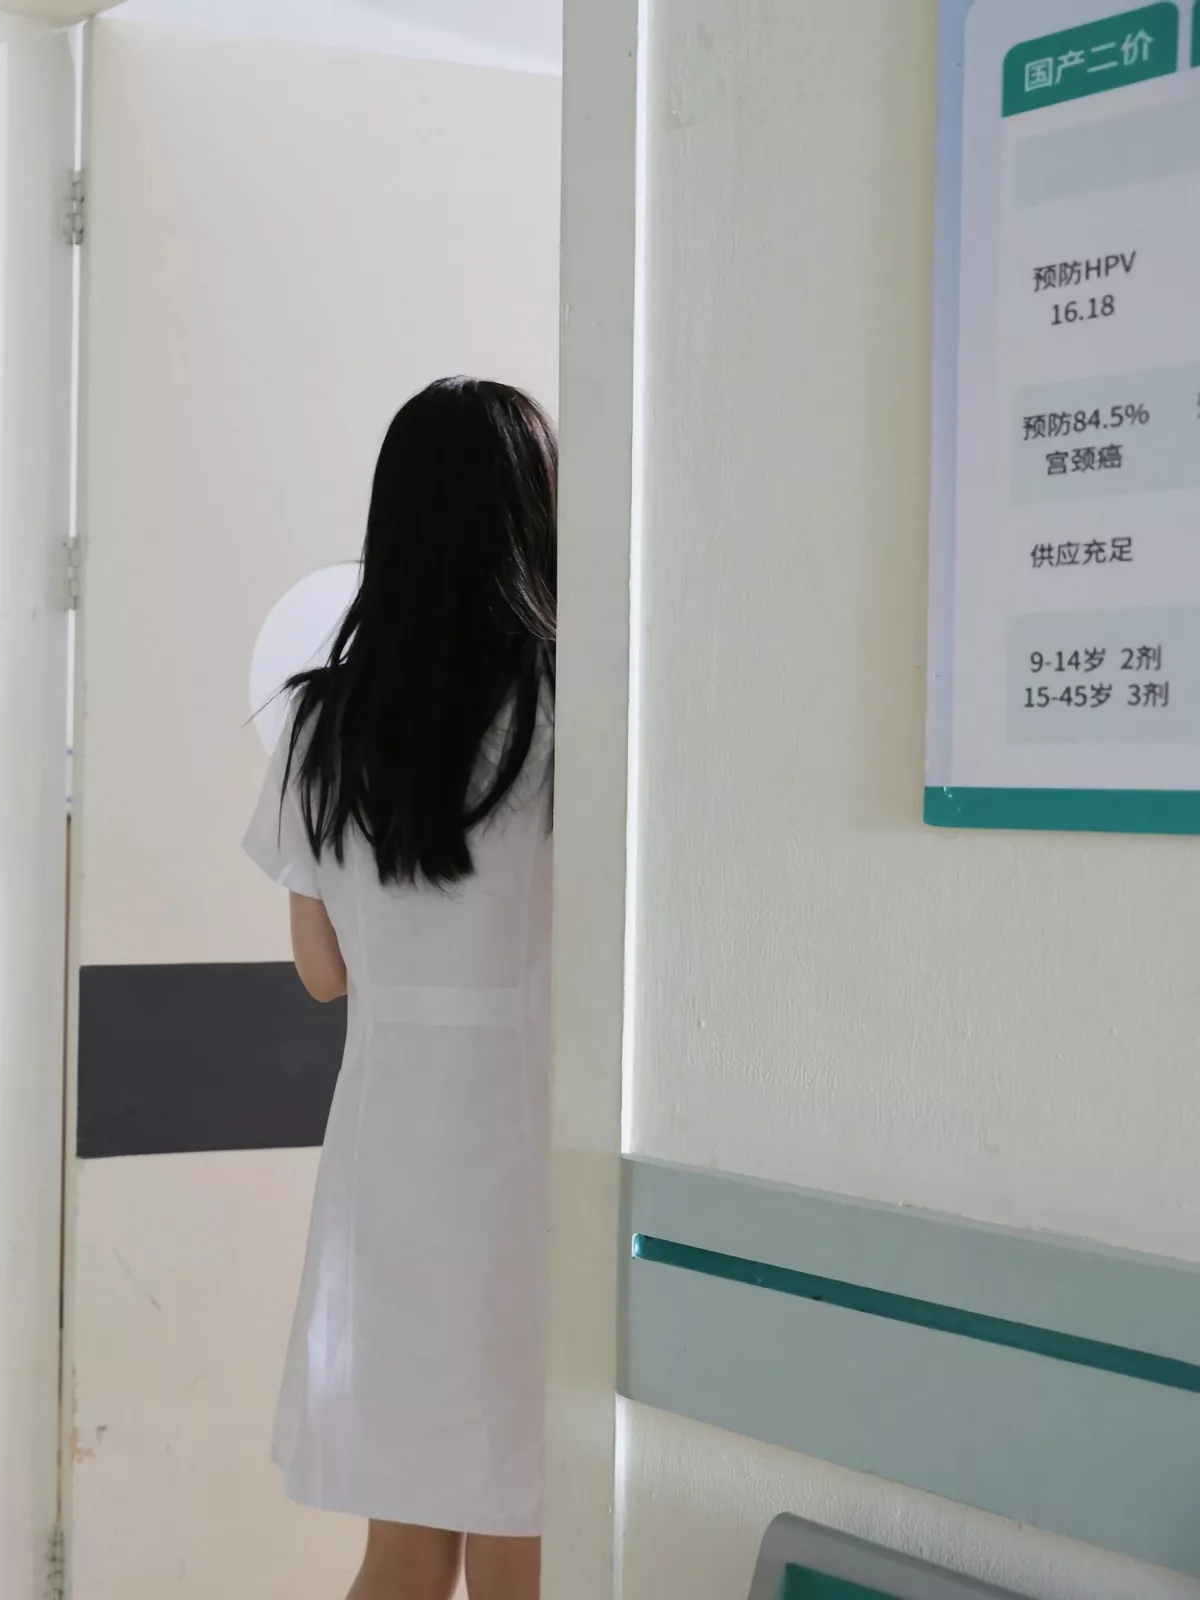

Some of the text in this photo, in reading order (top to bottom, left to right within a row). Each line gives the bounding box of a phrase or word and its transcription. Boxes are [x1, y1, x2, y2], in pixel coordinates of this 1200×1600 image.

[1024, 29, 1154, 92] 国产二价
[1032, 250, 1137, 292] 预防HPV
[1050, 294, 1115, 326] 16.18
[1022, 403, 1150, 441] 预防84.5%
[1045, 443, 1123, 476] 宫颈癌
[1030, 536, 1134, 568] 供应充足
[1030, 643, 1162, 673] 9-14岁 2剂
[1024, 680, 1169, 708] 15-45岁 3剂
